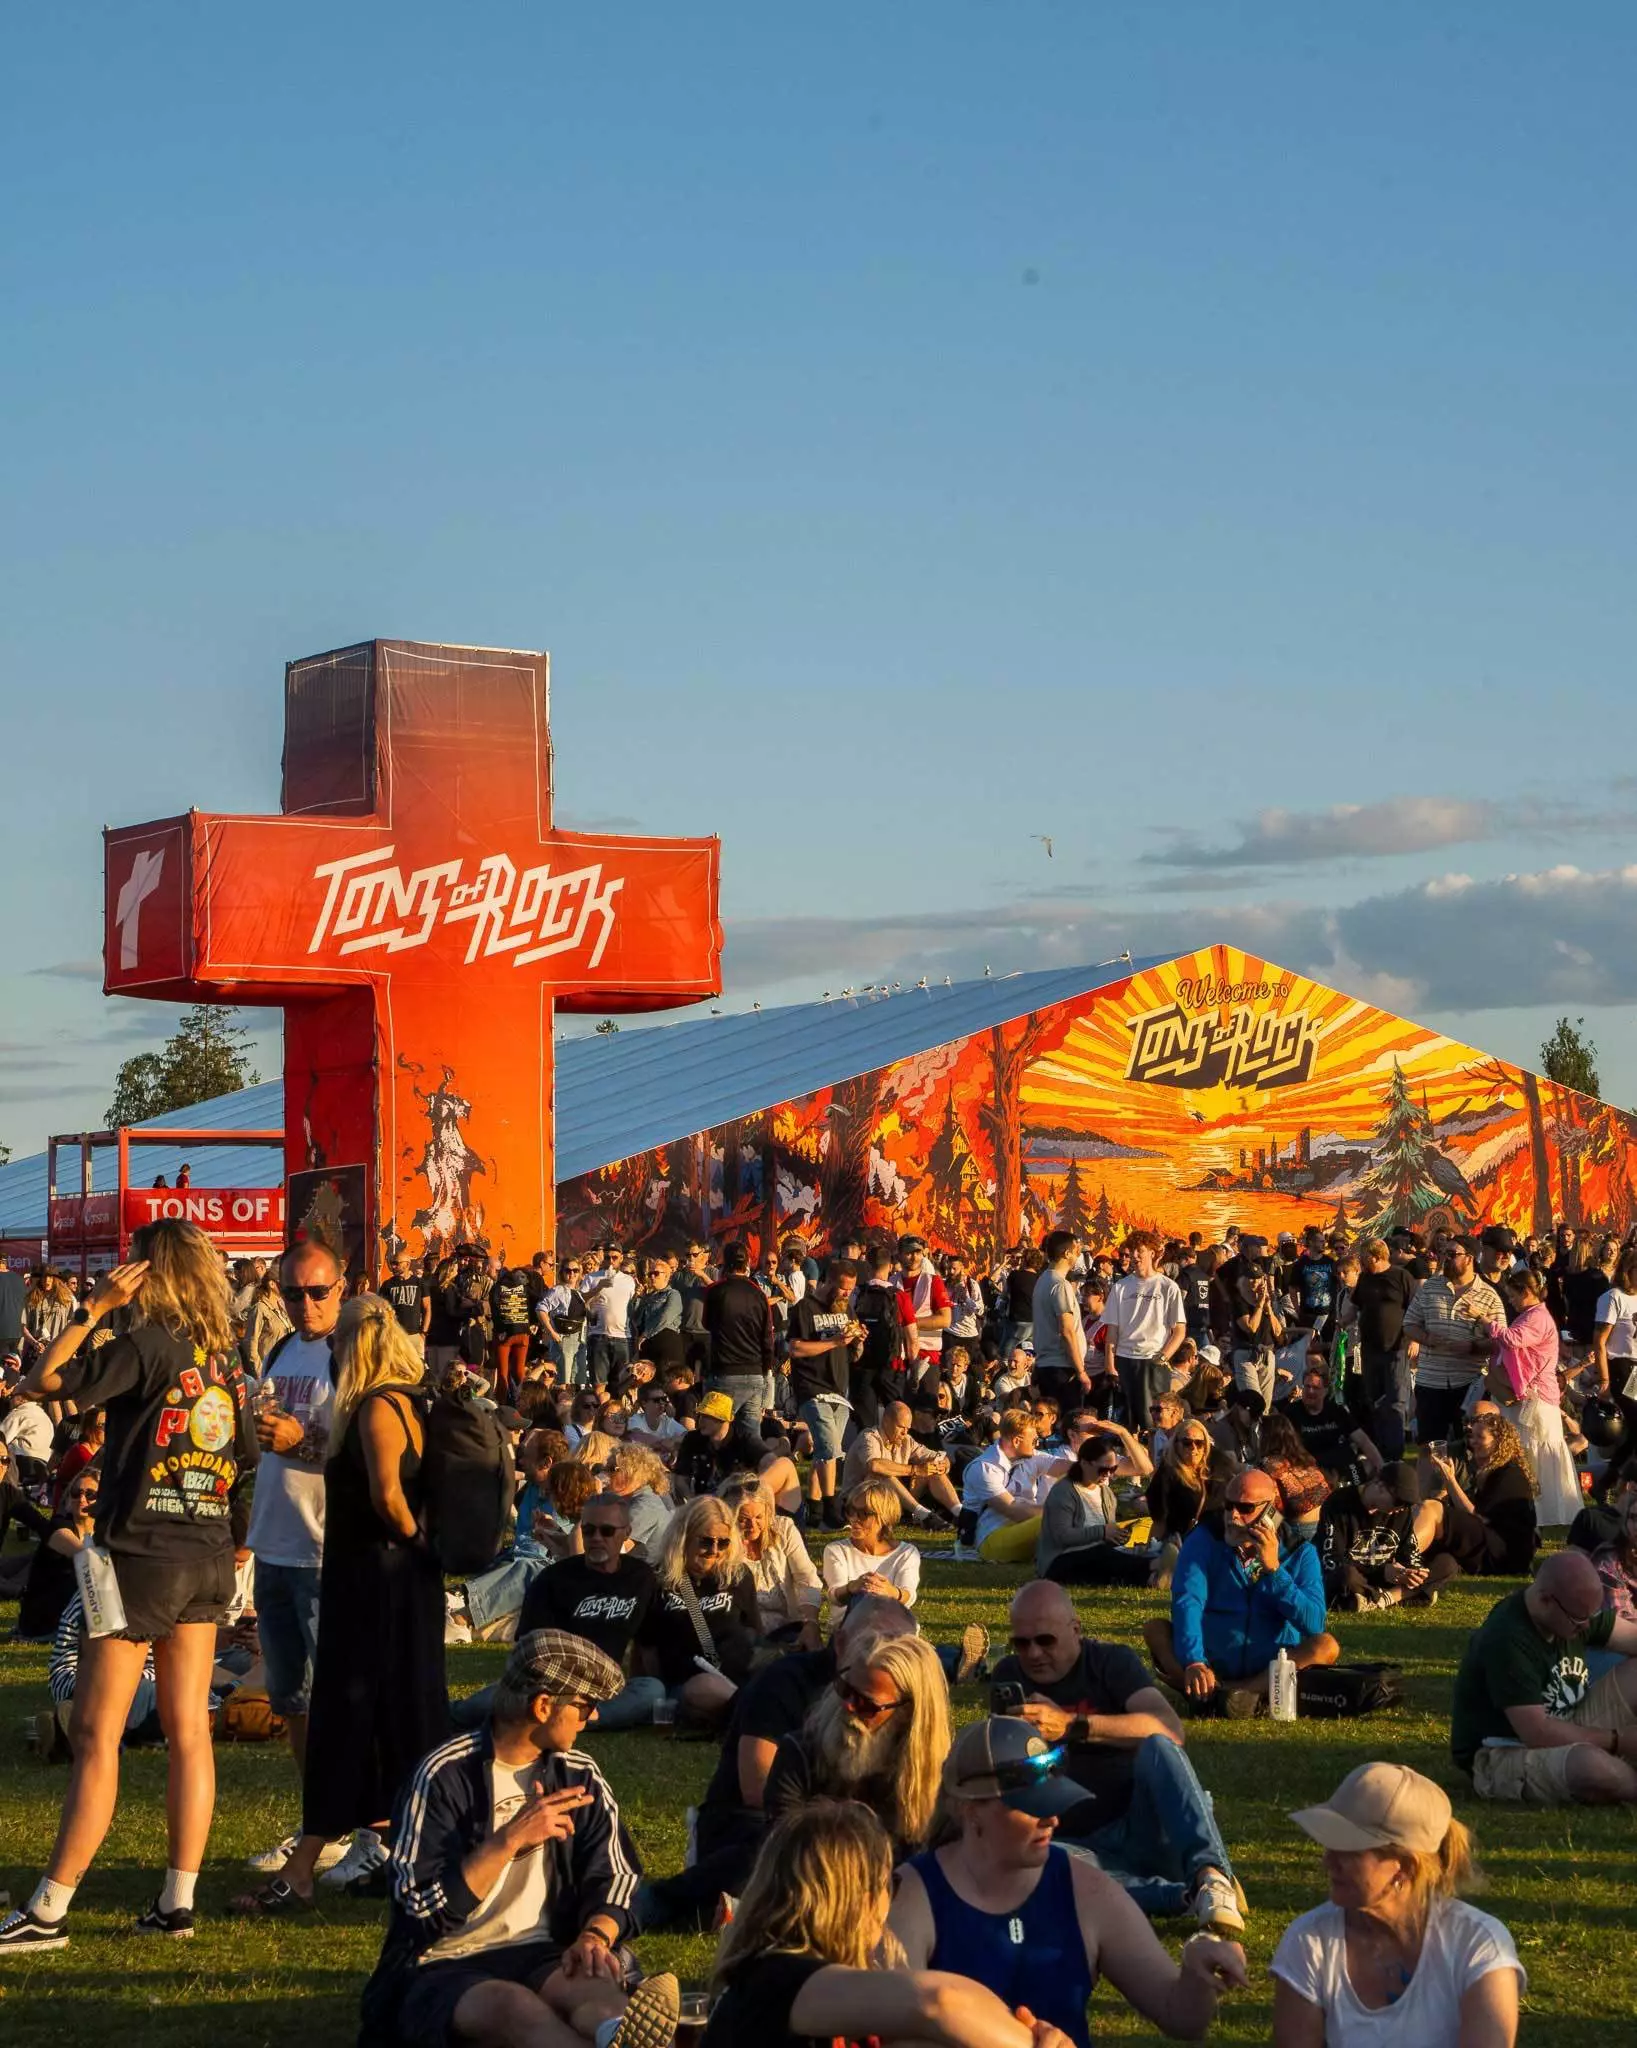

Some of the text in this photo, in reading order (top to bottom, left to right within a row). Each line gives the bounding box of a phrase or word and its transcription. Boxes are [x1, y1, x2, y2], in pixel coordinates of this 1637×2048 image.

[1176, 975, 1271, 1009] Welcome
[146, 1198, 223, 1221] TONS
[232, 1198, 269, 1221] OF
